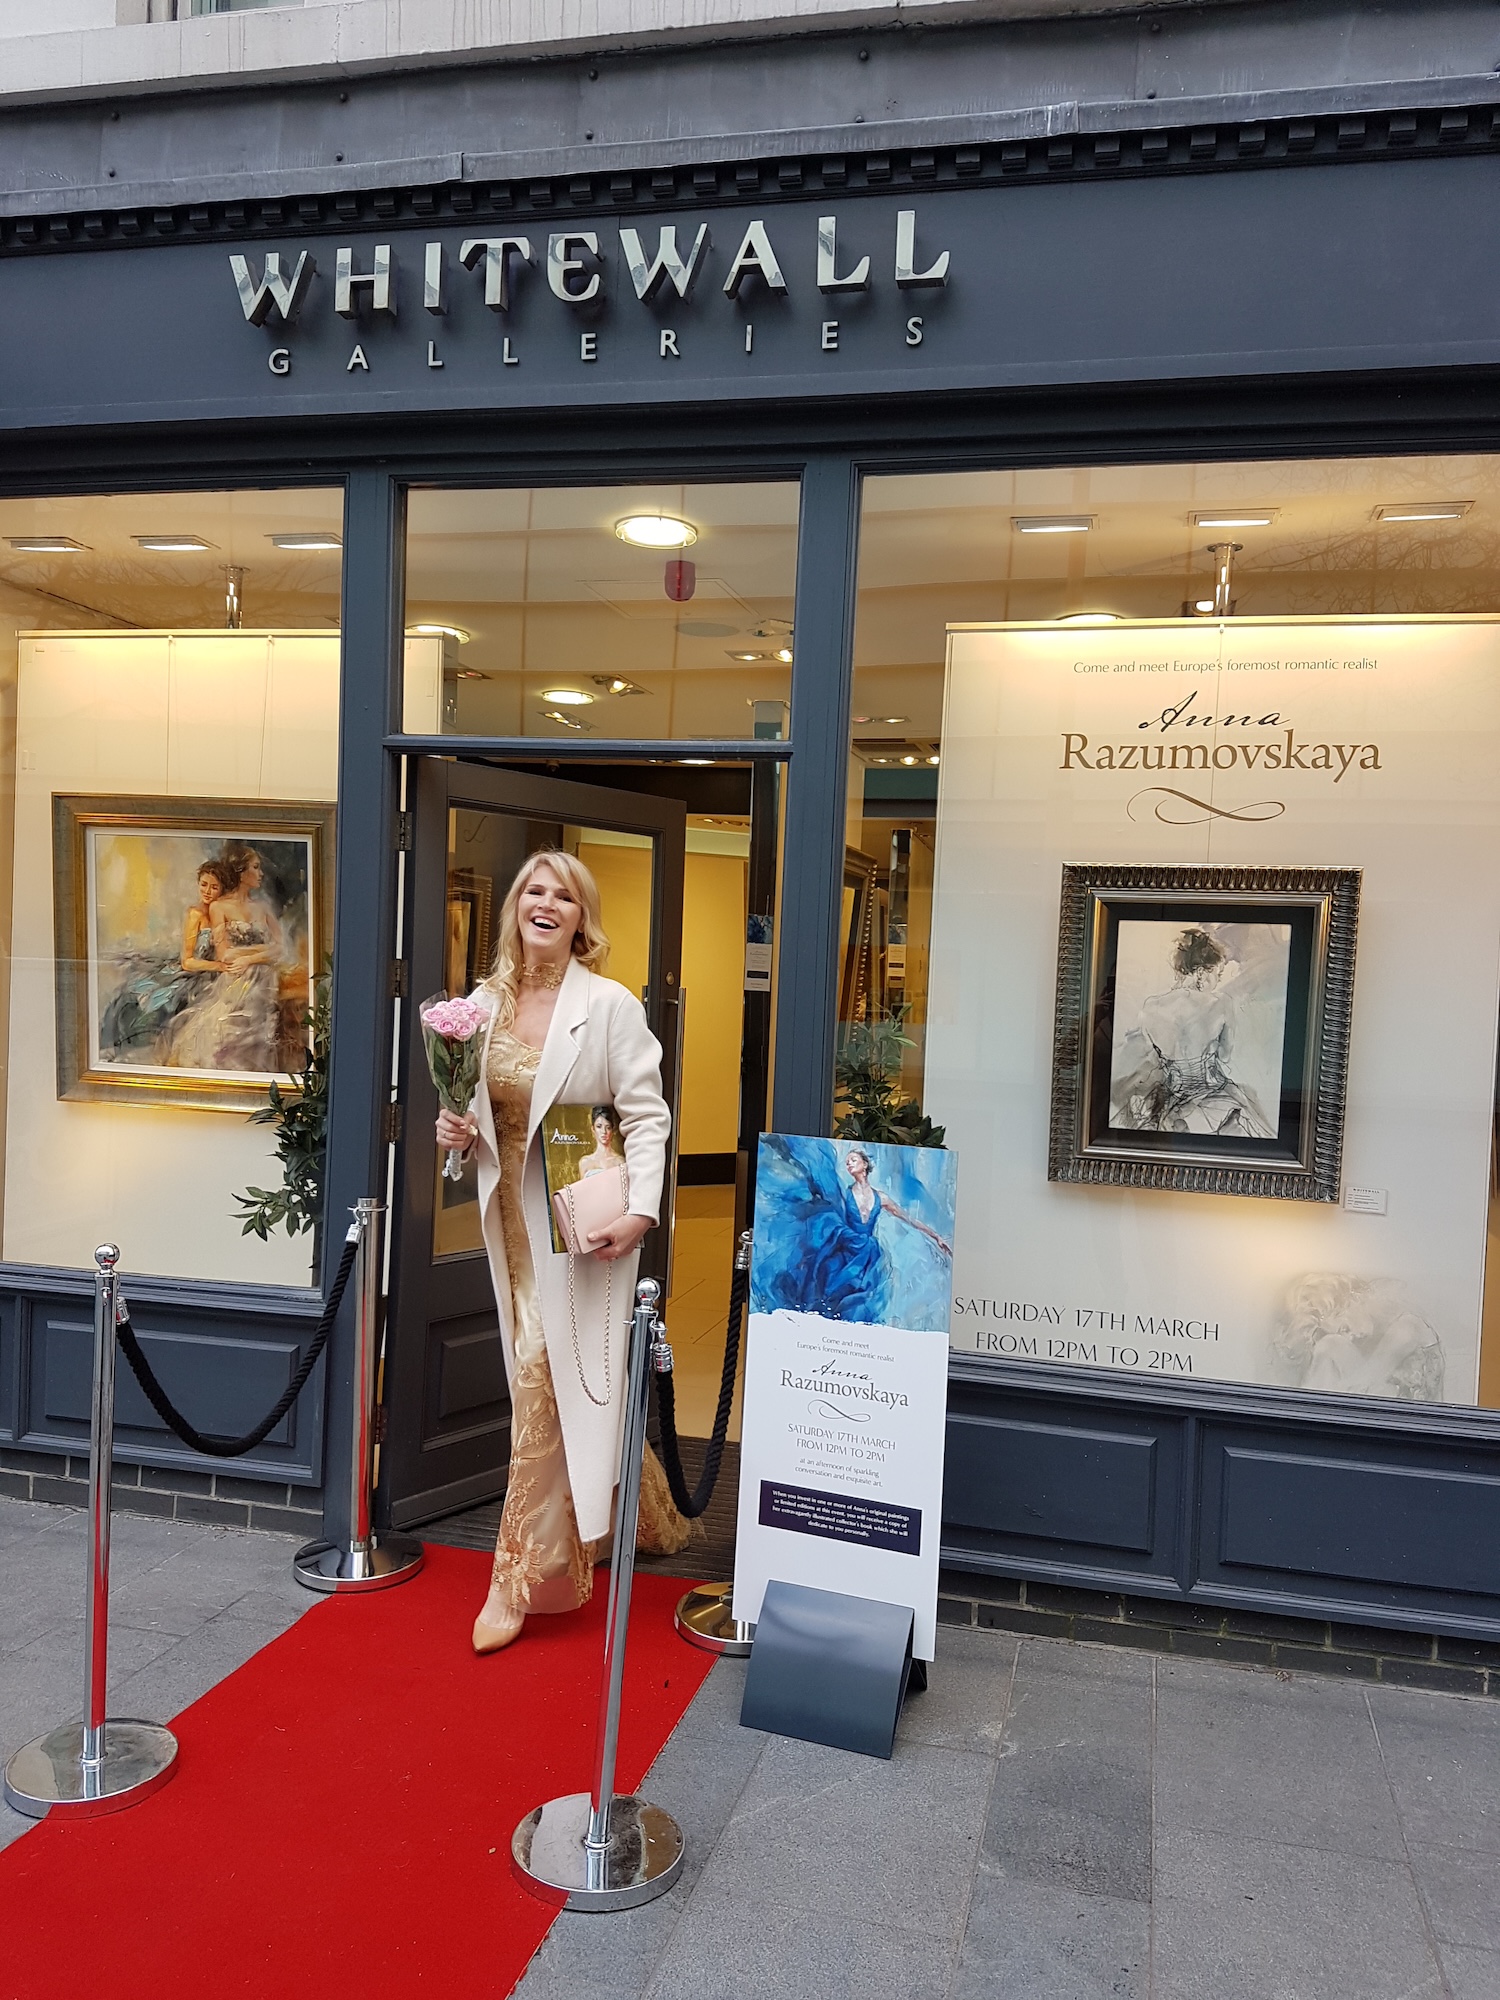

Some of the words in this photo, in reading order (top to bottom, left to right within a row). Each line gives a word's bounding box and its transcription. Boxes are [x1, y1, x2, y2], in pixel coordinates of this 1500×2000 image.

[229, 210, 950, 325] WHITEWALL
[267, 317, 925, 375] GALLERIES
[1073, 661, 1110, 673] Come
[1113, 660, 1136, 673] and
[1139, 660, 1169, 672] meet
[1173, 658, 1223, 674] Europe's
[1227, 658, 1280, 671] foremost
[1285, 658, 1340, 671] romantic
[1343, 657, 1378, 670] realist
[1138, 690, 1291, 733] Anna
[1058, 728, 1383, 783] Razumovskaya
[953, 1296, 1067, 1326] SATURDAY
[1074, 1308, 1126, 1332] 17TH
[1134, 1314, 1220, 1342] MARCH
[797, 1341, 821, 1352] Europe's
[822, 1345, 849, 1355] foremost
[850, 1350, 876, 1360] romantic
[877, 1354, 895, 1362] realist
[822, 1336, 840, 1345] Come
[841, 1340, 853, 1348] and
[854, 1342, 869, 1350] meet
[975, 1331, 1038, 1355] FROM
[1046, 1339, 1098, 1362] 12PM
[1106, 1345, 1139, 1366] TO
[1147, 1350, 1194, 1373] 2PM
[811, 1359, 872, 1381] Anna
[780, 1369, 909, 1410] Razumovskaya
[787, 1423, 835, 1440] SATURDAY
[837, 1431, 859, 1444] 17TH
[860, 1435, 896, 1450] MARCH
[796, 1438, 823, 1452] FROM
[825, 1443, 847, 1456] 12PM
[850, 1447, 864, 1458] TO
[866, 1450, 885, 1463] 2PM
[794, 1466, 833, 1477] conversation
[833, 1472, 845, 1480] and
[845, 1475, 872, 1487] exquisite
[815, 1459, 845, 1471] afternoon
[853, 1467, 880, 1479] sparkling
